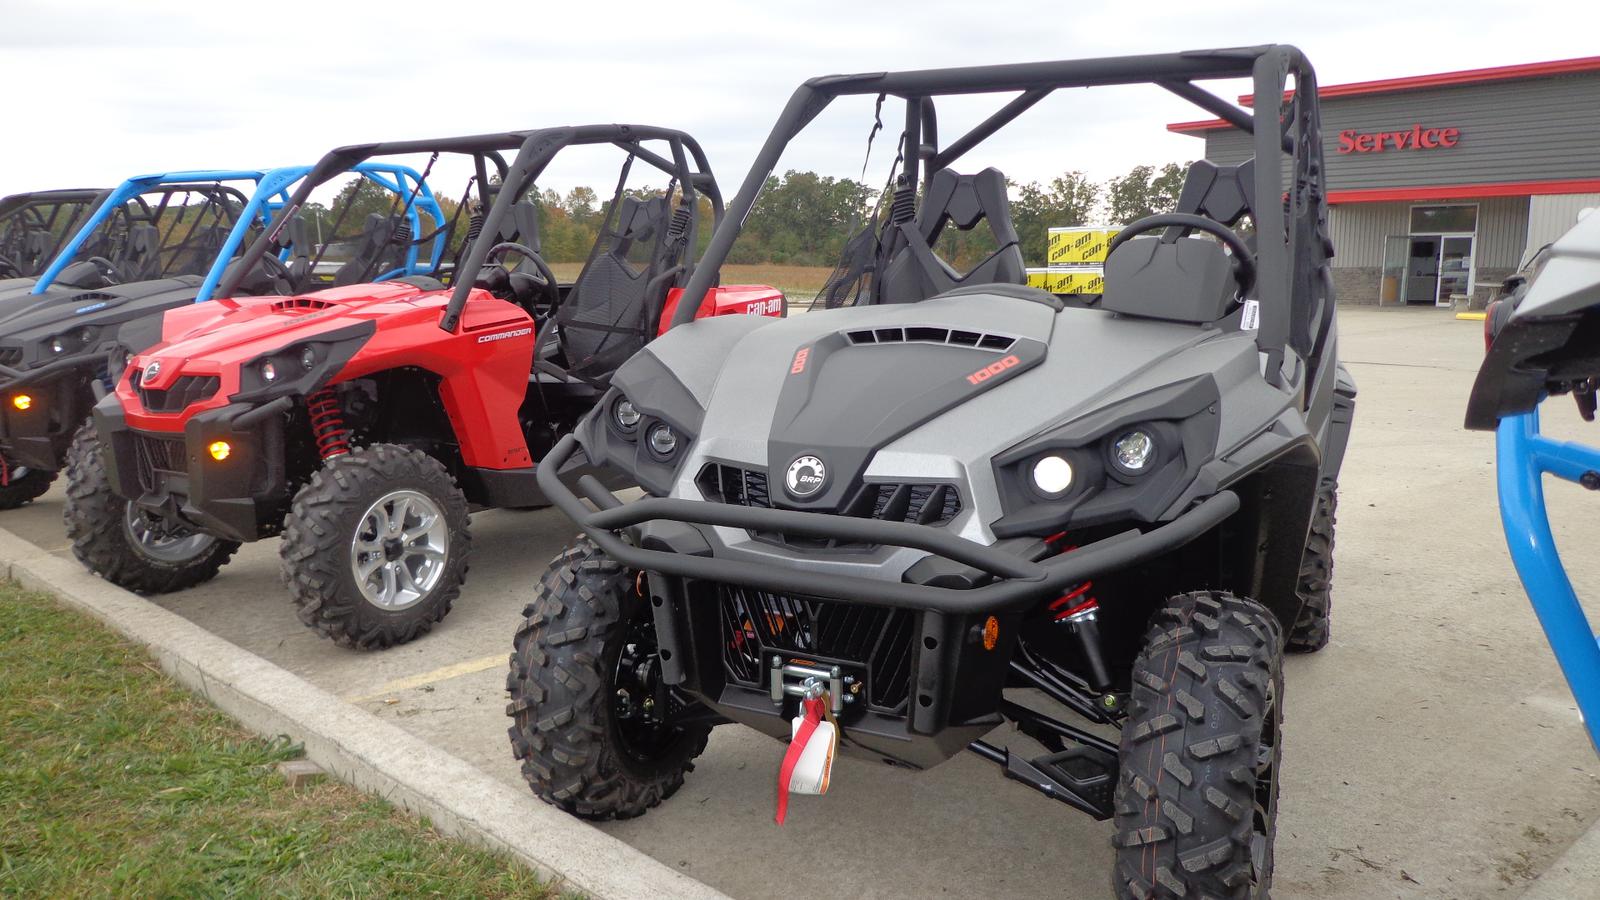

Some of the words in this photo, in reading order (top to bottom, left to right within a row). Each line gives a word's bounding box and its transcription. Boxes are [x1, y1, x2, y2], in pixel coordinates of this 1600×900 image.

[1336, 123, 1459, 154] Service
[1051, 232, 1091, 261] can-am
[746, 298, 782, 315] can-am
[478, 328, 532, 343] COMMANDER
[790, 347, 810, 375] 1000
[966, 355, 1020, 385] 1000
[799, 475, 822, 484] BRP
